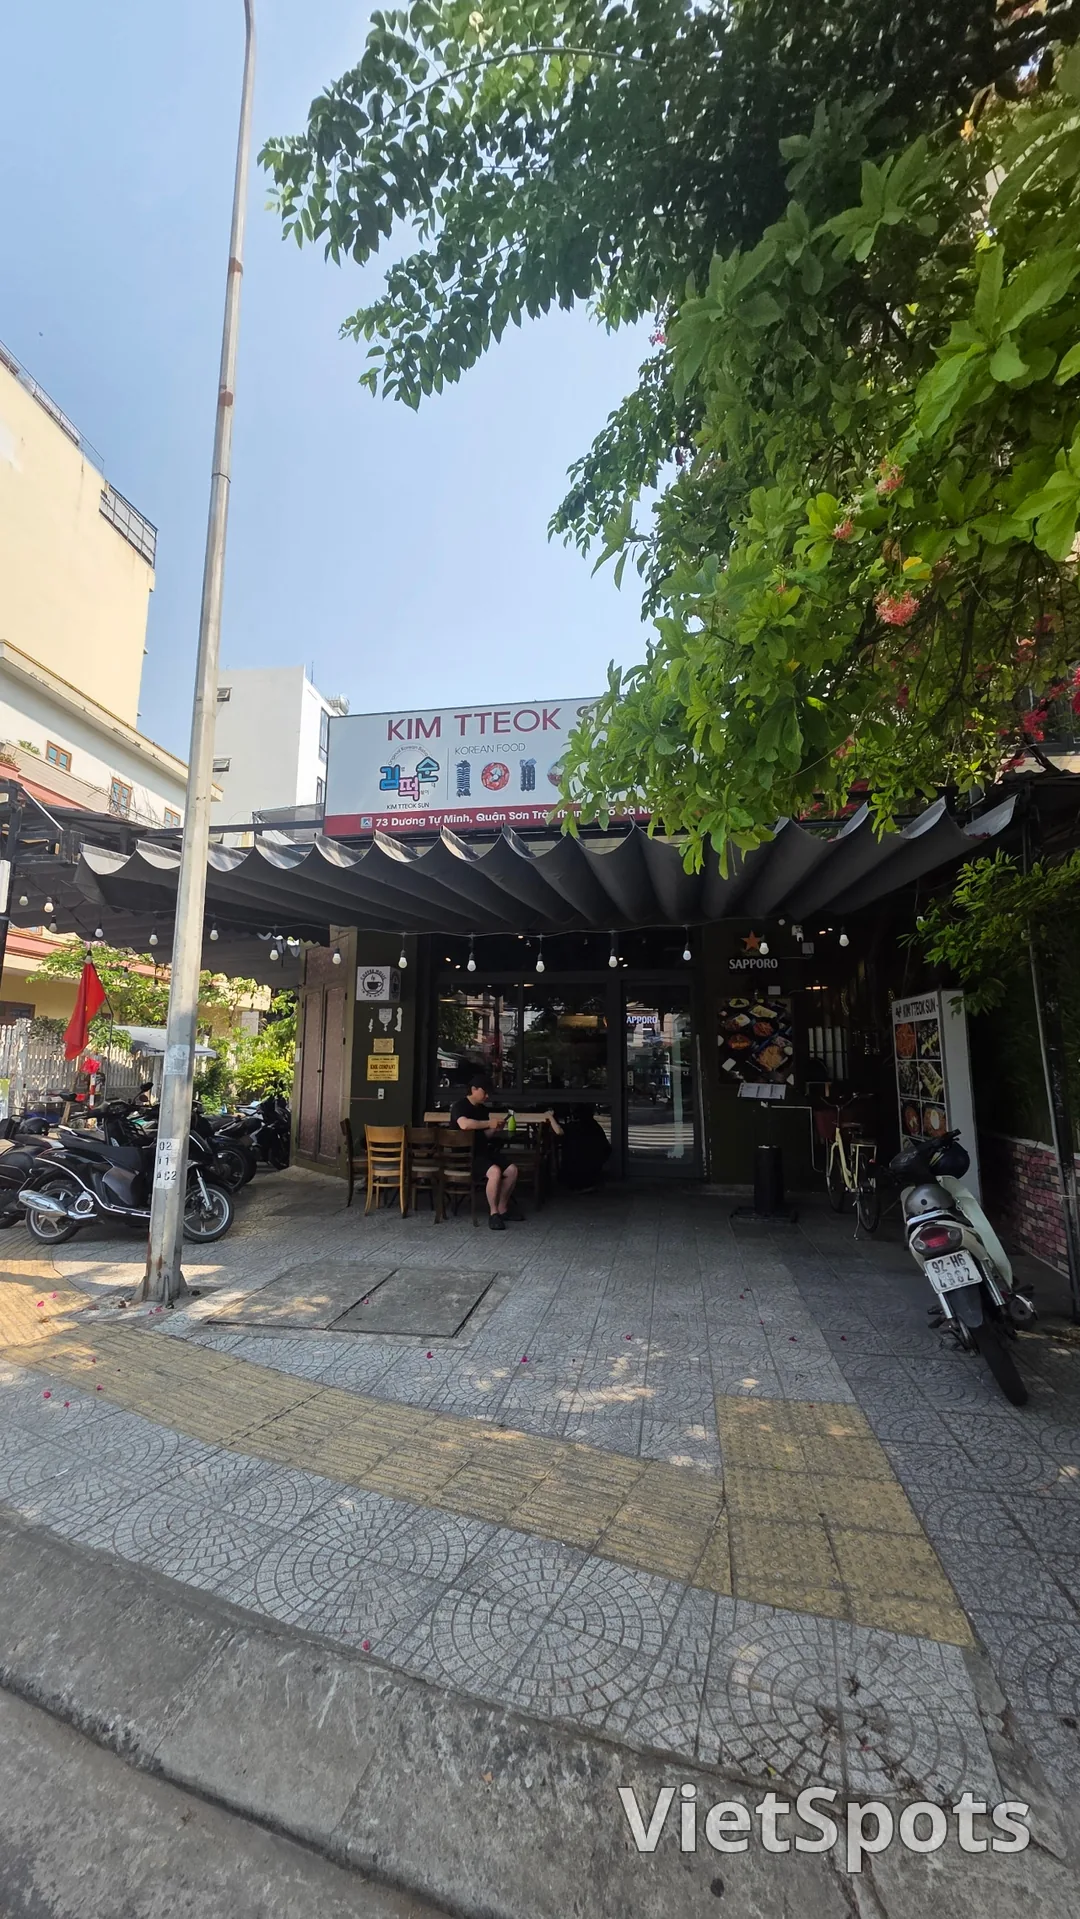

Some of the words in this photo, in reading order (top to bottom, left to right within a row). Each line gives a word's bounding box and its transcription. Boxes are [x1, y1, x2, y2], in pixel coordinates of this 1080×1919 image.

[387, 716, 441, 741] KIM
[454, 708, 562, 736] TTEOK
[455, 745, 494, 755] KOREAN
[497, 743, 526, 753] FOOD
[376, 818, 388, 827] 73
[391, 816, 426, 828] Dương
[428, 815, 441, 826] Tự
[443, 814, 473, 824] Minh,
[476, 811, 506, 823] Quận
[509, 811, 529, 820] Sơn
[728, 958, 779, 970] SAPPORO
[925, 997, 937, 1014] SUN
[626, 1015, 657, 1024] APPORO
[159, 1141, 172, 1151] 02
[931, 1253, 966, 1274] 92-H6
